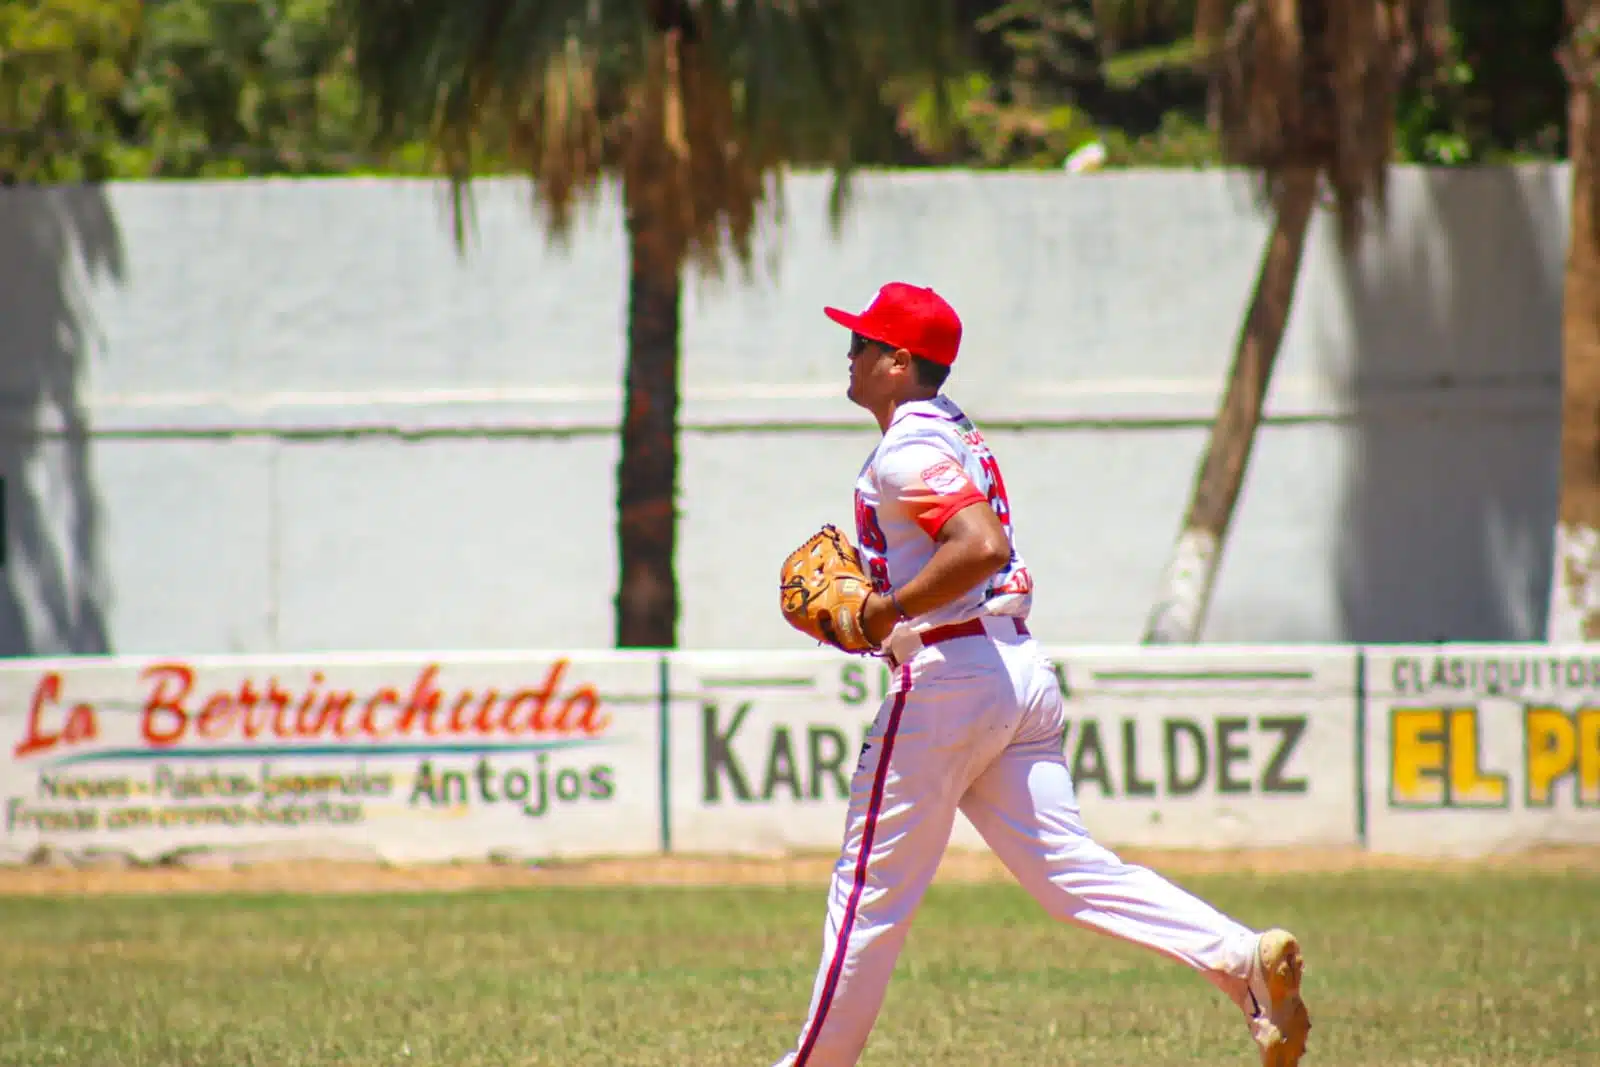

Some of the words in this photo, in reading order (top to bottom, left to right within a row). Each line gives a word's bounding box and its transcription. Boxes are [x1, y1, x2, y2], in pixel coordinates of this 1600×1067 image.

[13, 670, 98, 758] La
[139, 658, 609, 748] Berrinchuda
[702, 700, 872, 803] KAR
[1063, 715, 1308, 797] ALDEZ
[1388, 704, 1509, 810] EL
[410, 754, 616, 816] Antojos
